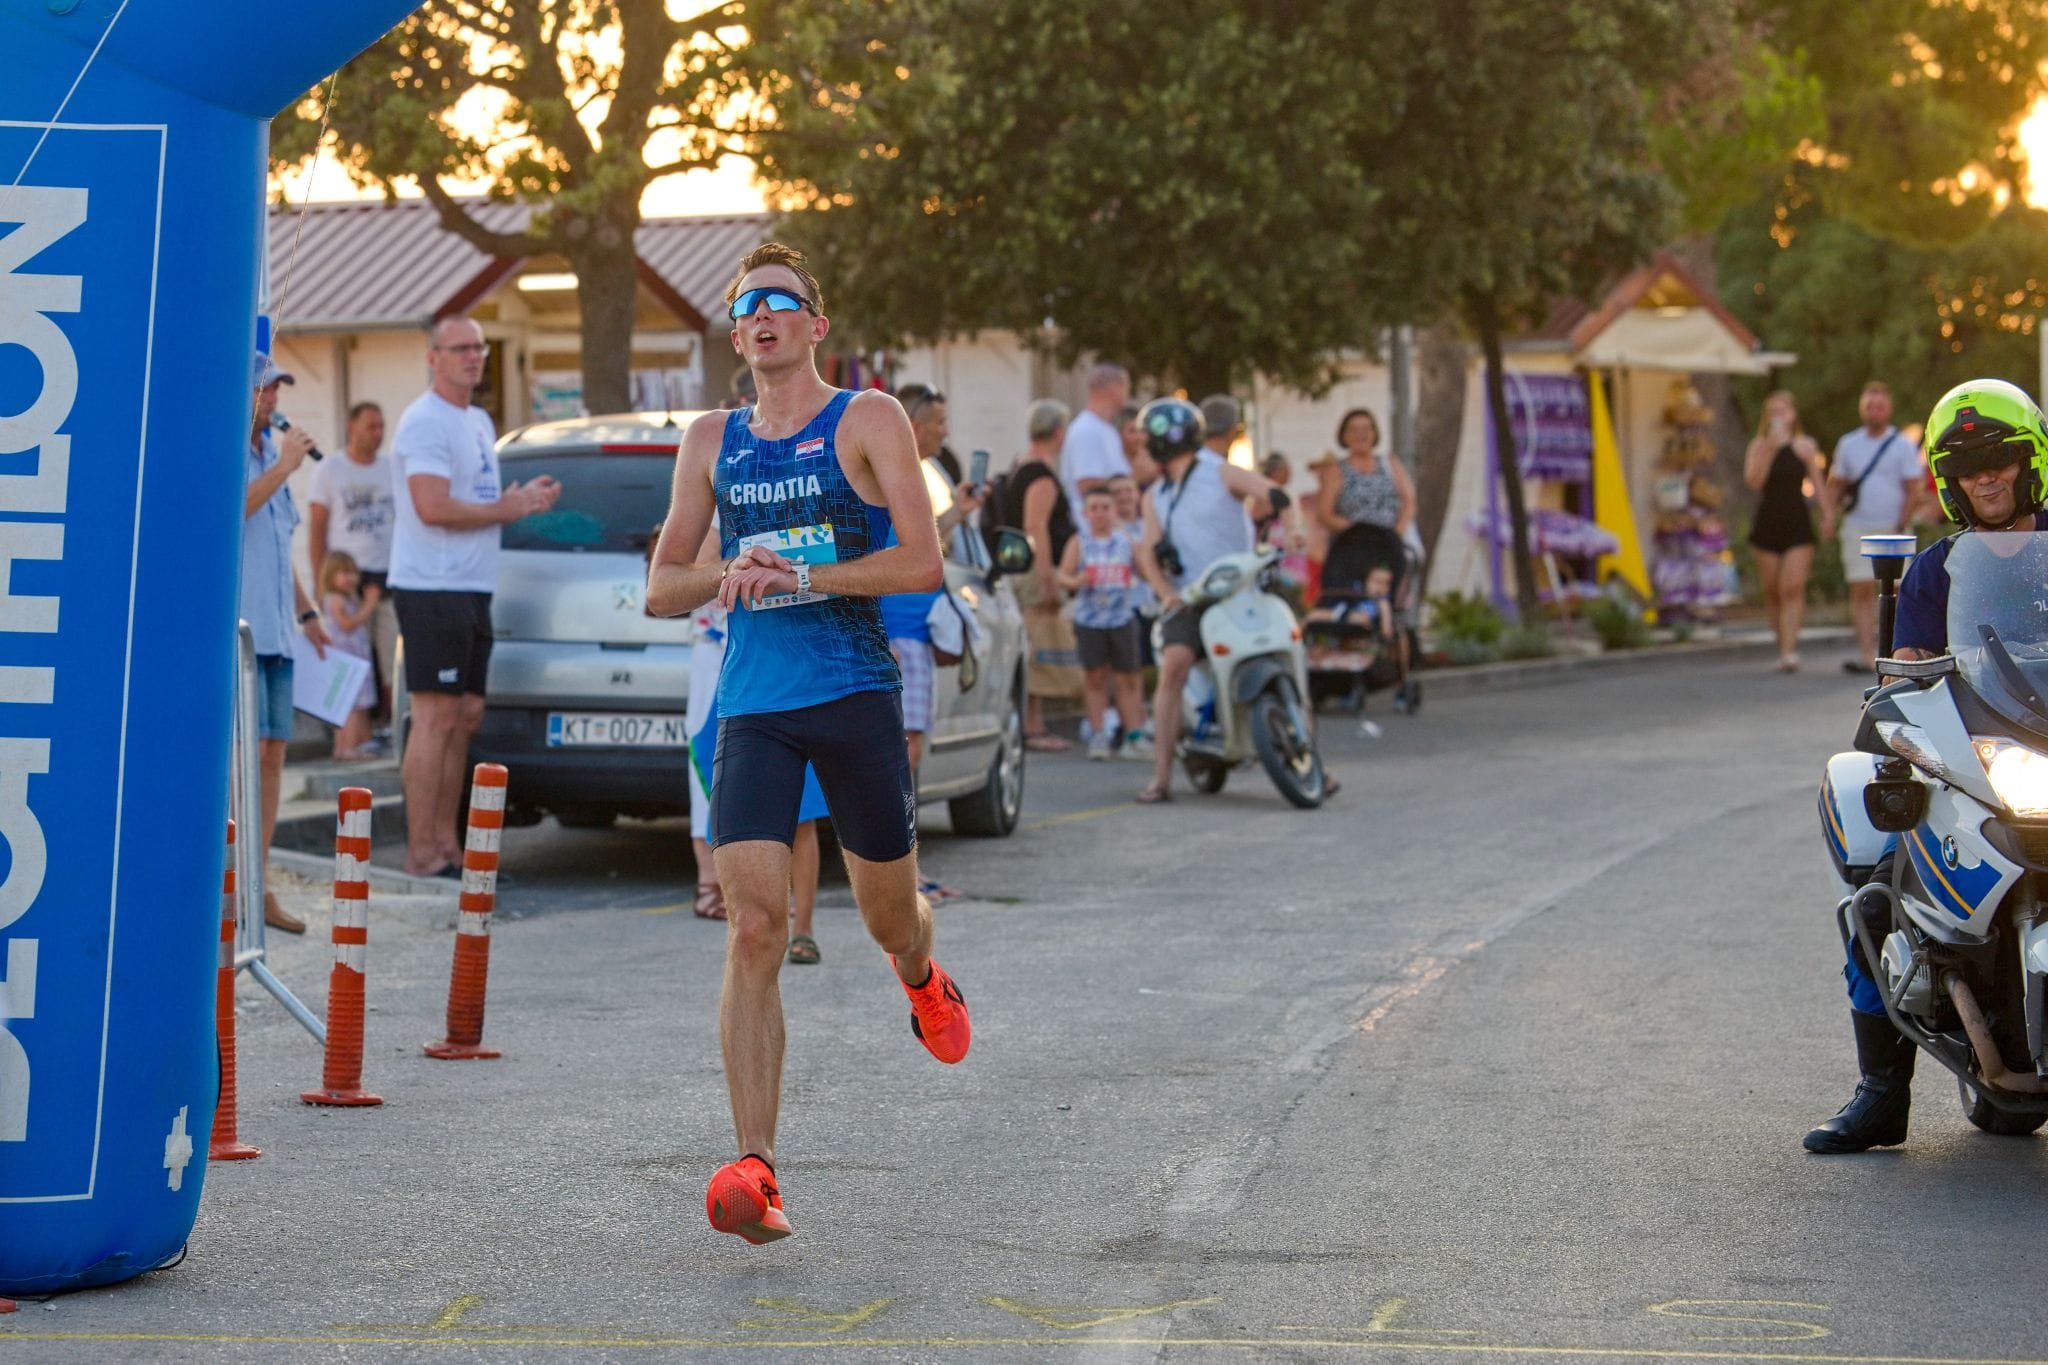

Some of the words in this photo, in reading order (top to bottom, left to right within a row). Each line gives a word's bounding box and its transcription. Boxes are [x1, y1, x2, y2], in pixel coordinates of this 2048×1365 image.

[729, 474, 823, 506] CROATIA
[565, 718, 592, 740] KT
[331, 1296, 1832, 1340] START
